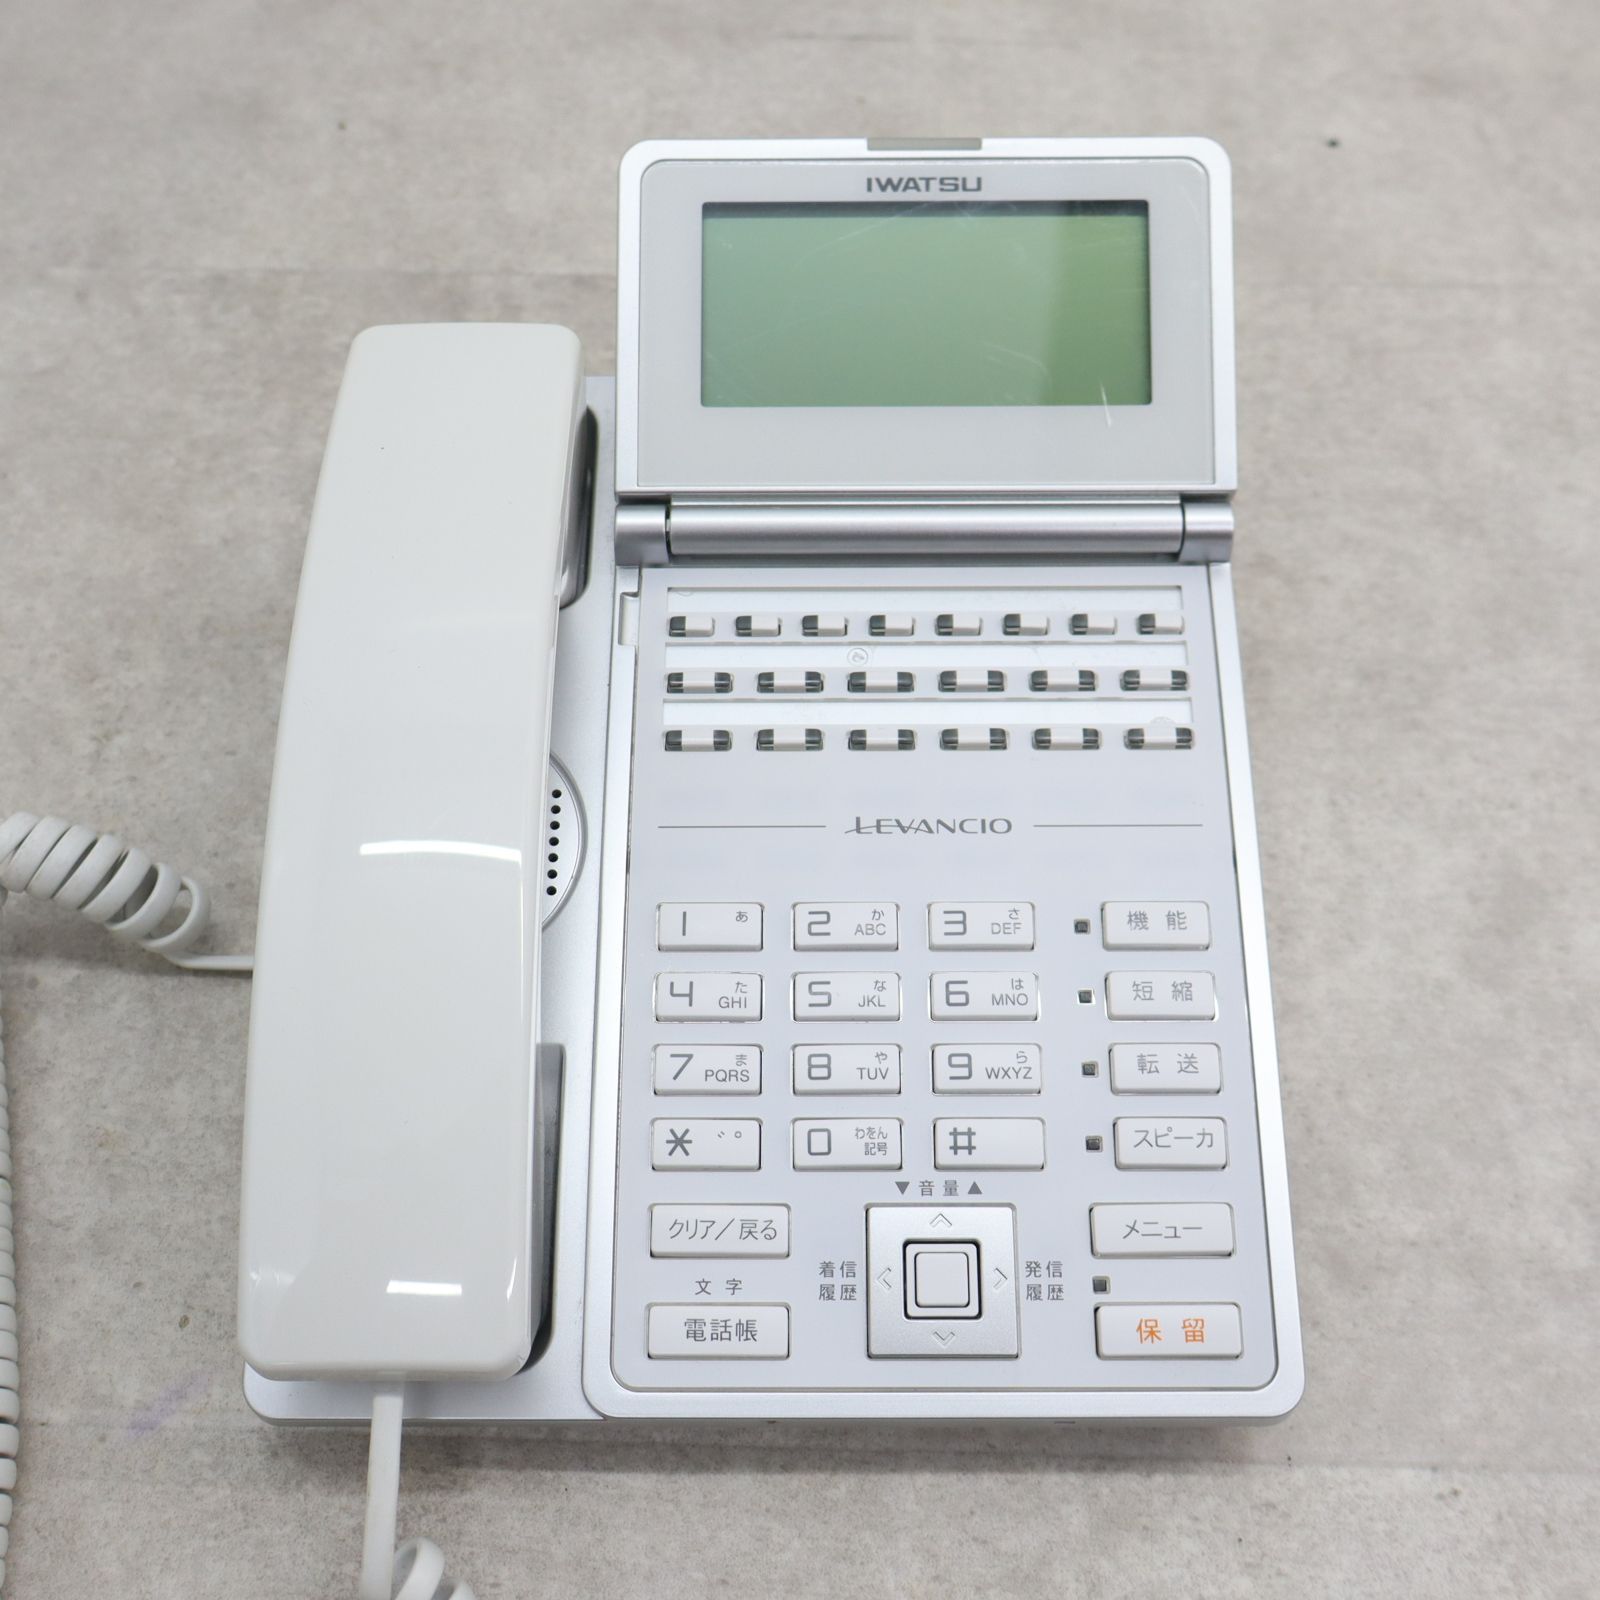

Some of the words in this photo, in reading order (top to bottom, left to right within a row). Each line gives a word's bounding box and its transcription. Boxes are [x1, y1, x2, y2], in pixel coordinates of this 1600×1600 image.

[866, 176, 983, 193] IWATSU
[844, 816, 1013, 835] LEVANCIO
[735, 910, 749, 923] あ
[871, 908, 885, 921] か
[1007, 907, 1021, 921] さ
[680, 910, 688, 937] 1
[807, 910, 832, 937] 2
[853, 922, 887, 936] ABC
[942, 910, 968, 937] 3
[990, 921, 1022, 936] DEF
[734, 980, 748, 994] た
[873, 979, 887, 993] な
[1010, 977, 1025, 991] は
[669, 980, 694, 1008] 4
[807, 980, 832, 1008] 5
[857, 994, 887, 1008] JKL
[944, 979, 970, 1008] 6
[991, 992, 1029, 1007] MNO
[718, 995, 747, 1009] GHI
[735, 1053, 748, 1067] ま
[874, 1051, 888, 1065] や
[1015, 1050, 1028, 1065] ら
[669, 1053, 694, 1081] 7
[807, 1053, 832, 1081] 8
[855, 1067, 889, 1081] TUV
[947, 1052, 973, 1081] 9
[984, 1066, 1033, 1080] WXYZ
[704, 1068, 750, 1083] PQRS
[854, 1126, 888, 1140] わをん
[948, 1126, 977, 1156] #
[1133, 1126, 1214, 1149] スピーカ
[864, 1141, 888, 1156] 記号
[1122, 1219, 1203, 1240] メニュー
[818, 1260, 858, 1279] 着信
[1024, 1260, 1064, 1279] 発信
[818, 1283, 857, 1302] 履歴
[1025, 1283, 1065, 1302] 履歴
[684, 1318, 758, 1343] 電話帳
